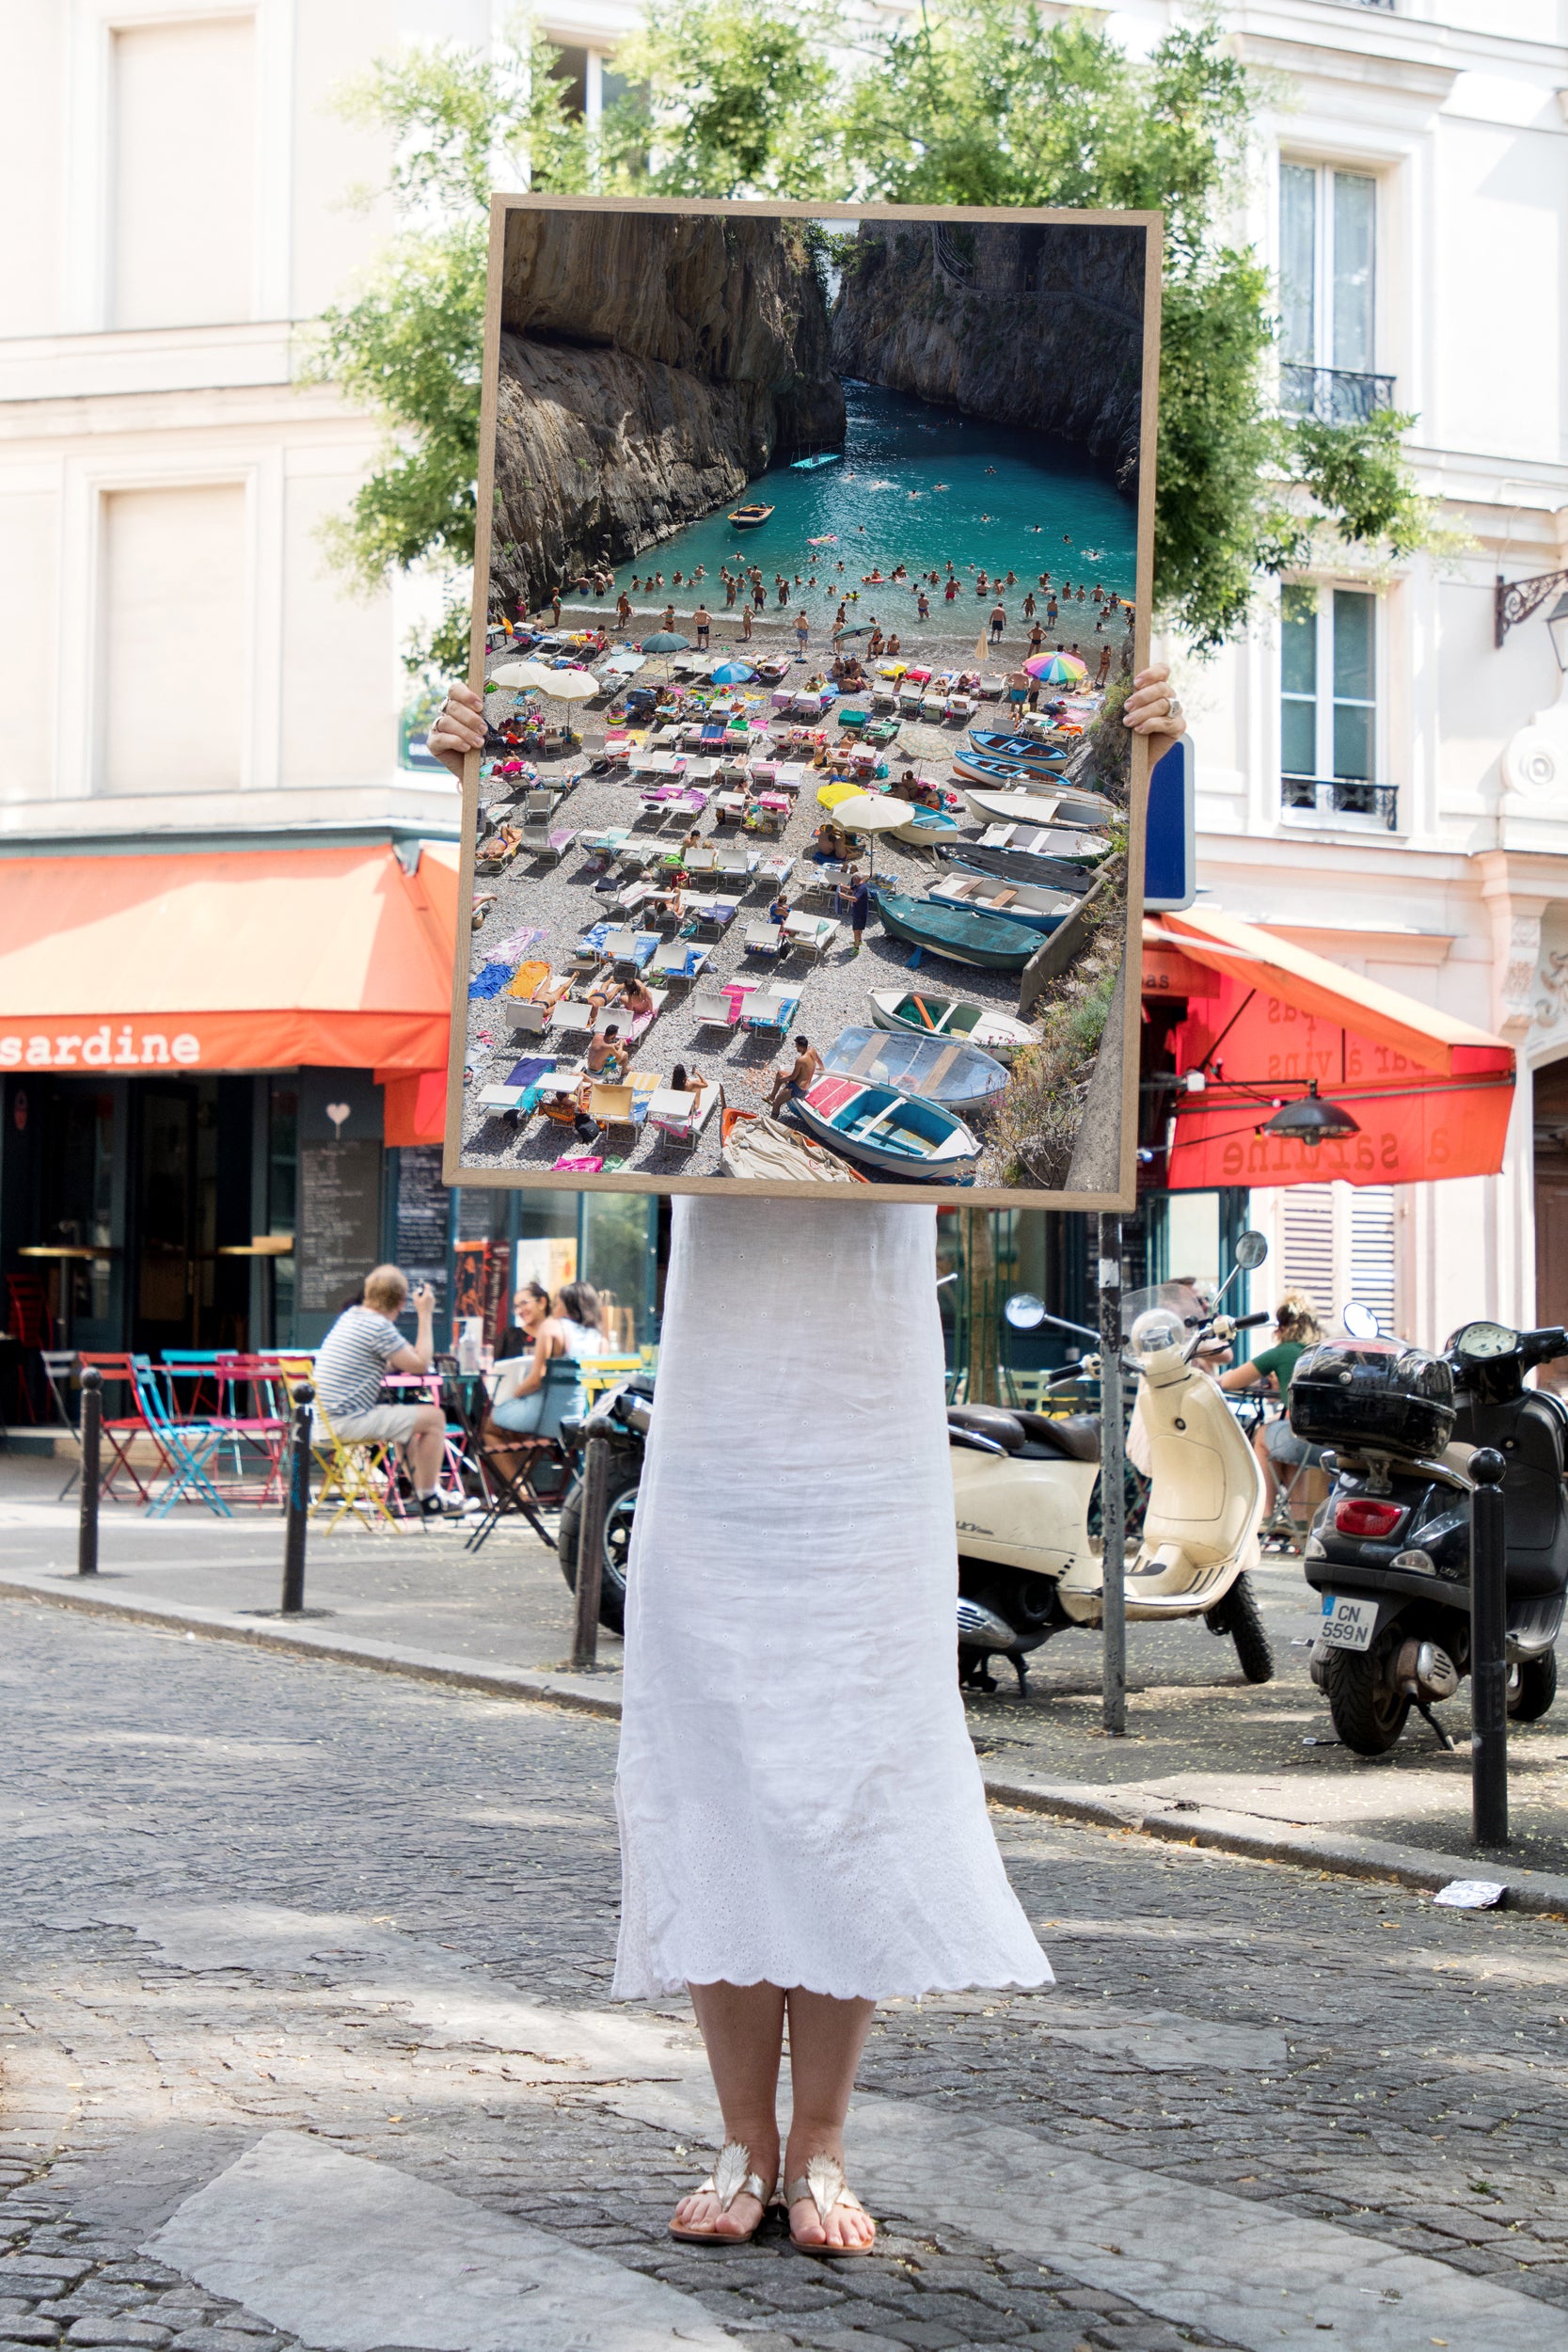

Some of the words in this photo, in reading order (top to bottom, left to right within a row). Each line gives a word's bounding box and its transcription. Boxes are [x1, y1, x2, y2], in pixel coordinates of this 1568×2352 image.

[1142, 974, 1169, 990] as
[0, 1025, 200, 1065] sardine
[1338, 1605, 1361, 1623] CN
[1322, 1621, 1369, 1644] 559N
